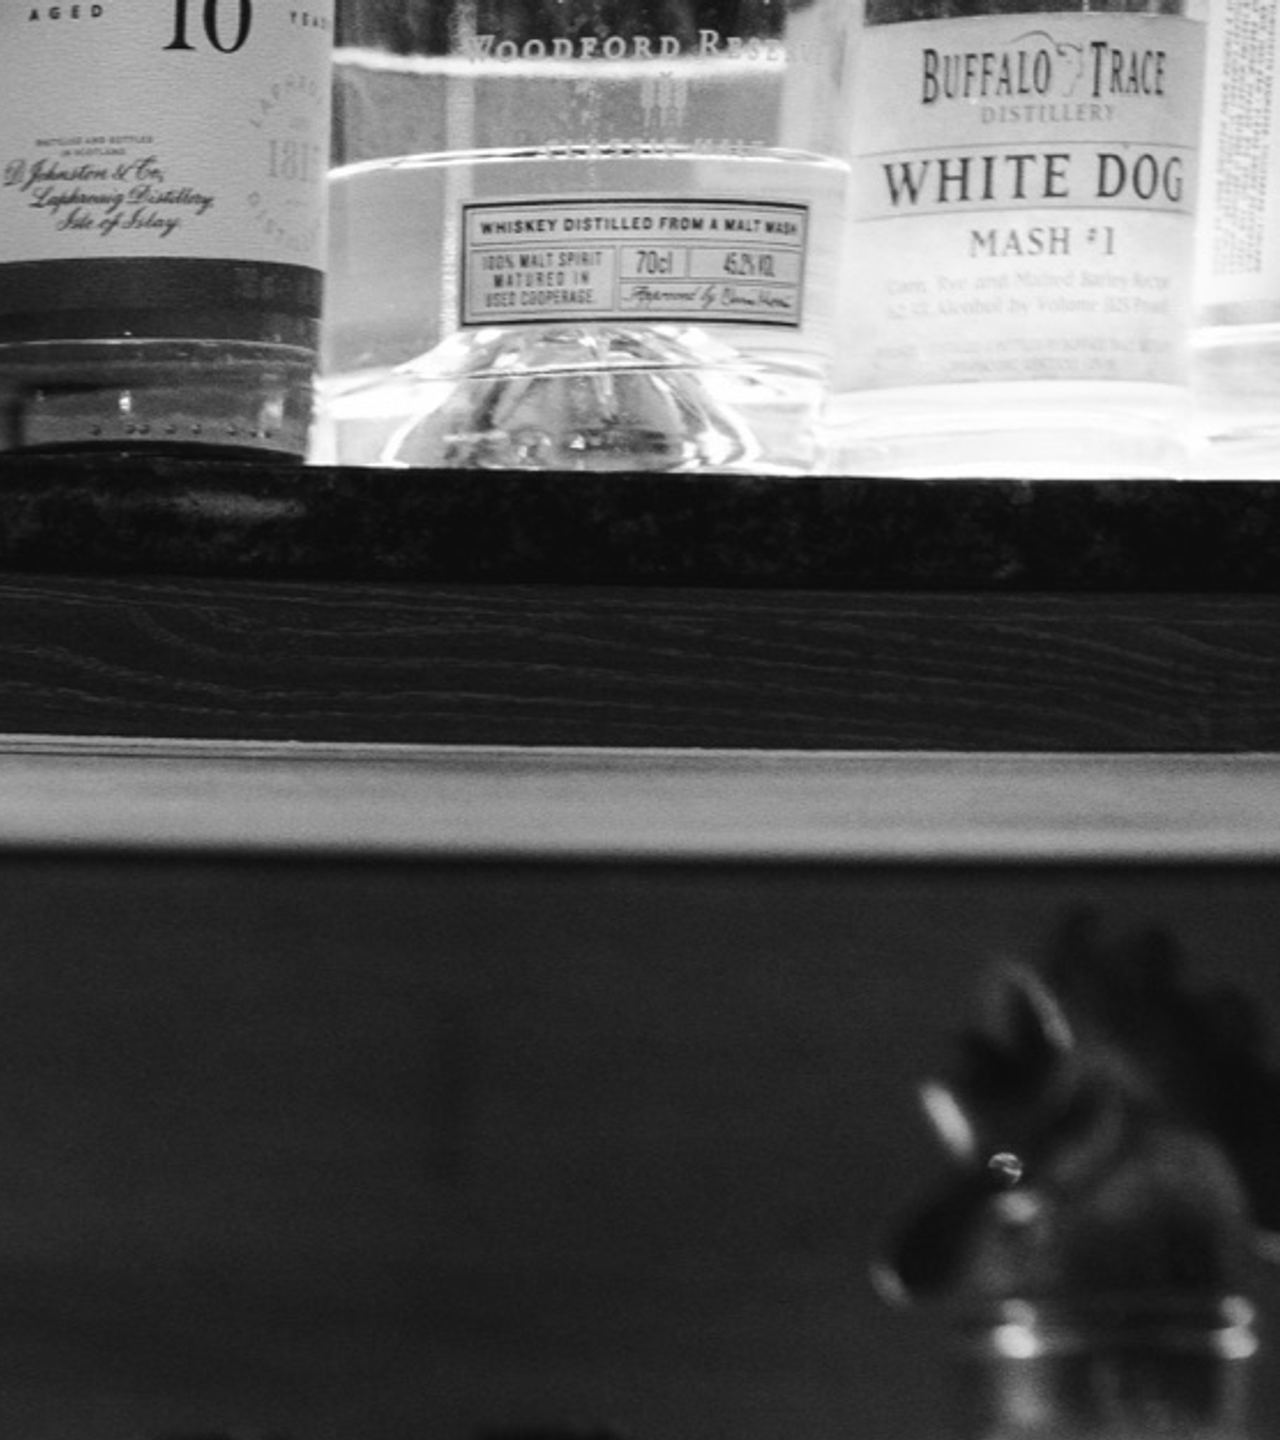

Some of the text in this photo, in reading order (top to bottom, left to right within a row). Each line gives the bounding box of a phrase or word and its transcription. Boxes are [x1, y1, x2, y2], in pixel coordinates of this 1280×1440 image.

[29, 3, 103, 22] AGED
[161, 0, 253, 54] 10
[922, 41, 1167, 105] BUFFALO TRACE
[980, 103, 1117, 125] DISTILLERY
[20, 158, 108, 192] Johnston
[882, 153, 1184, 208] WHITE DOG
[56, 206, 94, 232] Isle
[96, 211, 125, 238] of
[481, 218, 558, 235] WHISKEY
[563, 216, 653, 232] DISTILLED
[659, 216, 704, 231] FROM
[709, 217, 719, 231] A
[724, 218, 761, 233] MALT
[968, 226, 1071, 259] MASH
[519, 252, 554, 269] MALT
[558, 251, 603, 267] SPIRIT
[494, 271, 565, 288] MATURED
